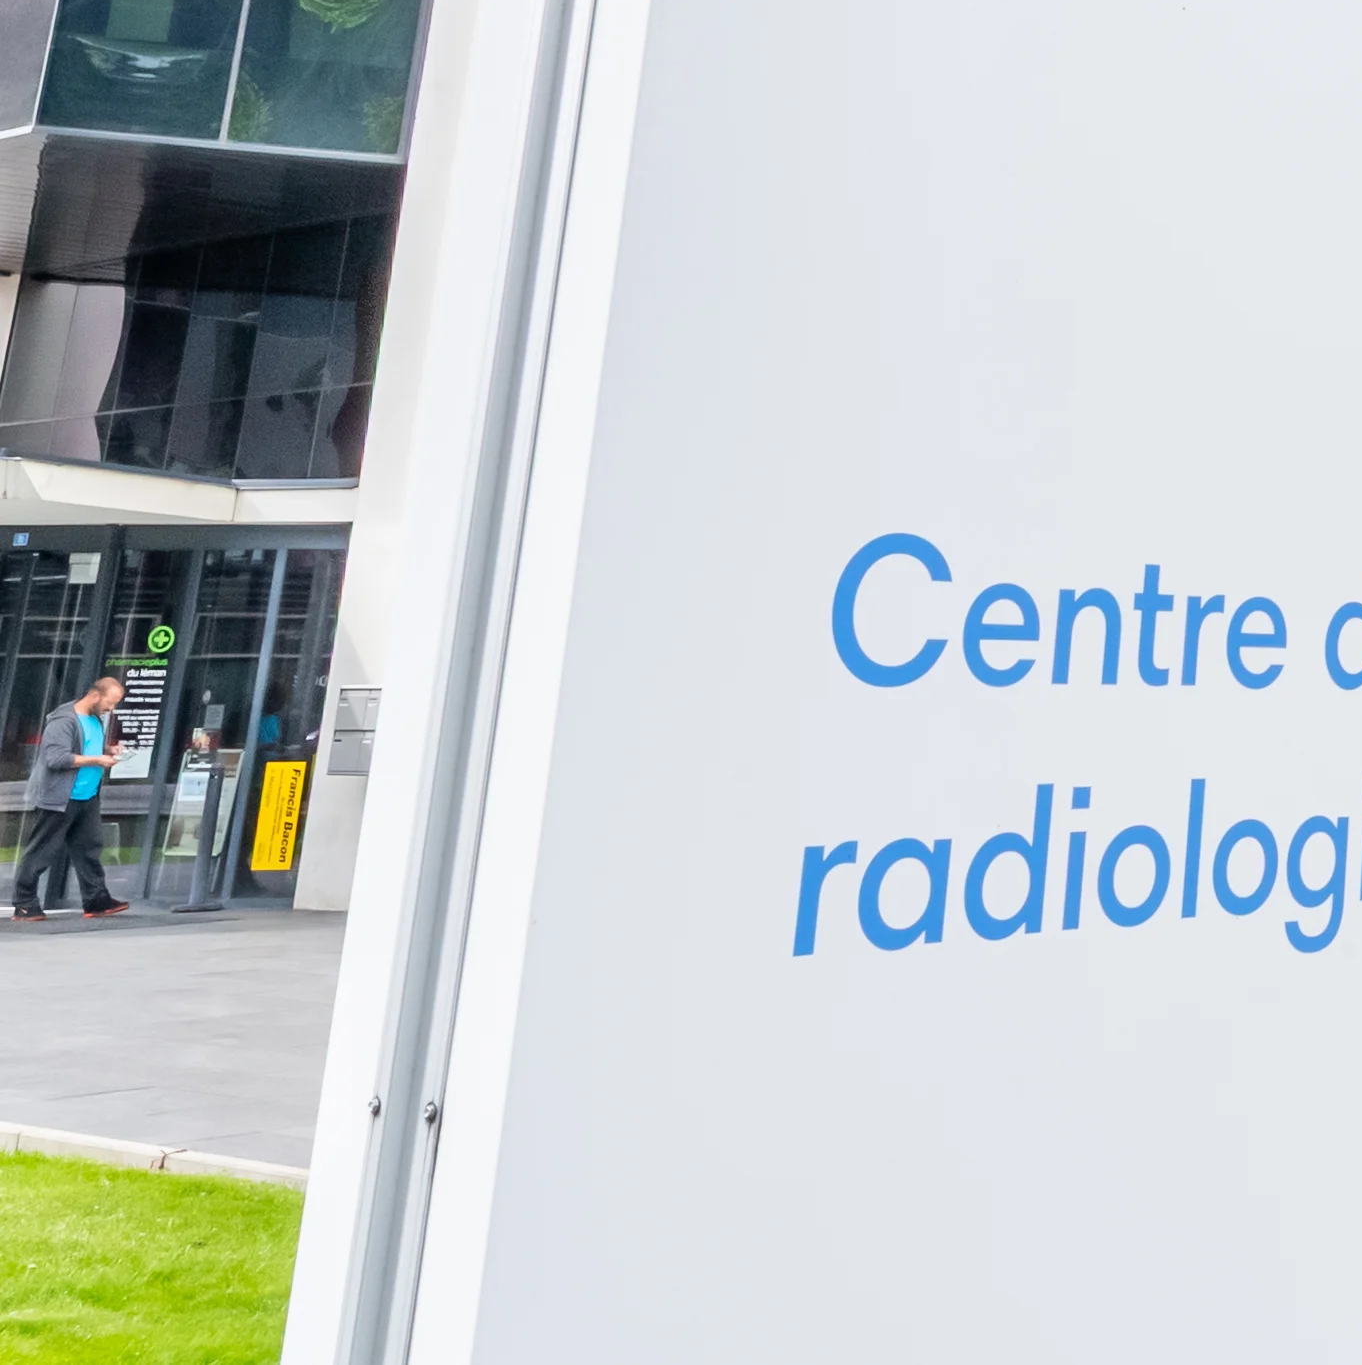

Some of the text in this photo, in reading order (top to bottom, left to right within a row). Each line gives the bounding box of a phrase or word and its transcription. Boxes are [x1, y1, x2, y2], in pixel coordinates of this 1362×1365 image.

[831, 532, 1287, 689] Centre
[286, 768, 301, 817] Francis
[279, 822, 293, 863] Bacon
